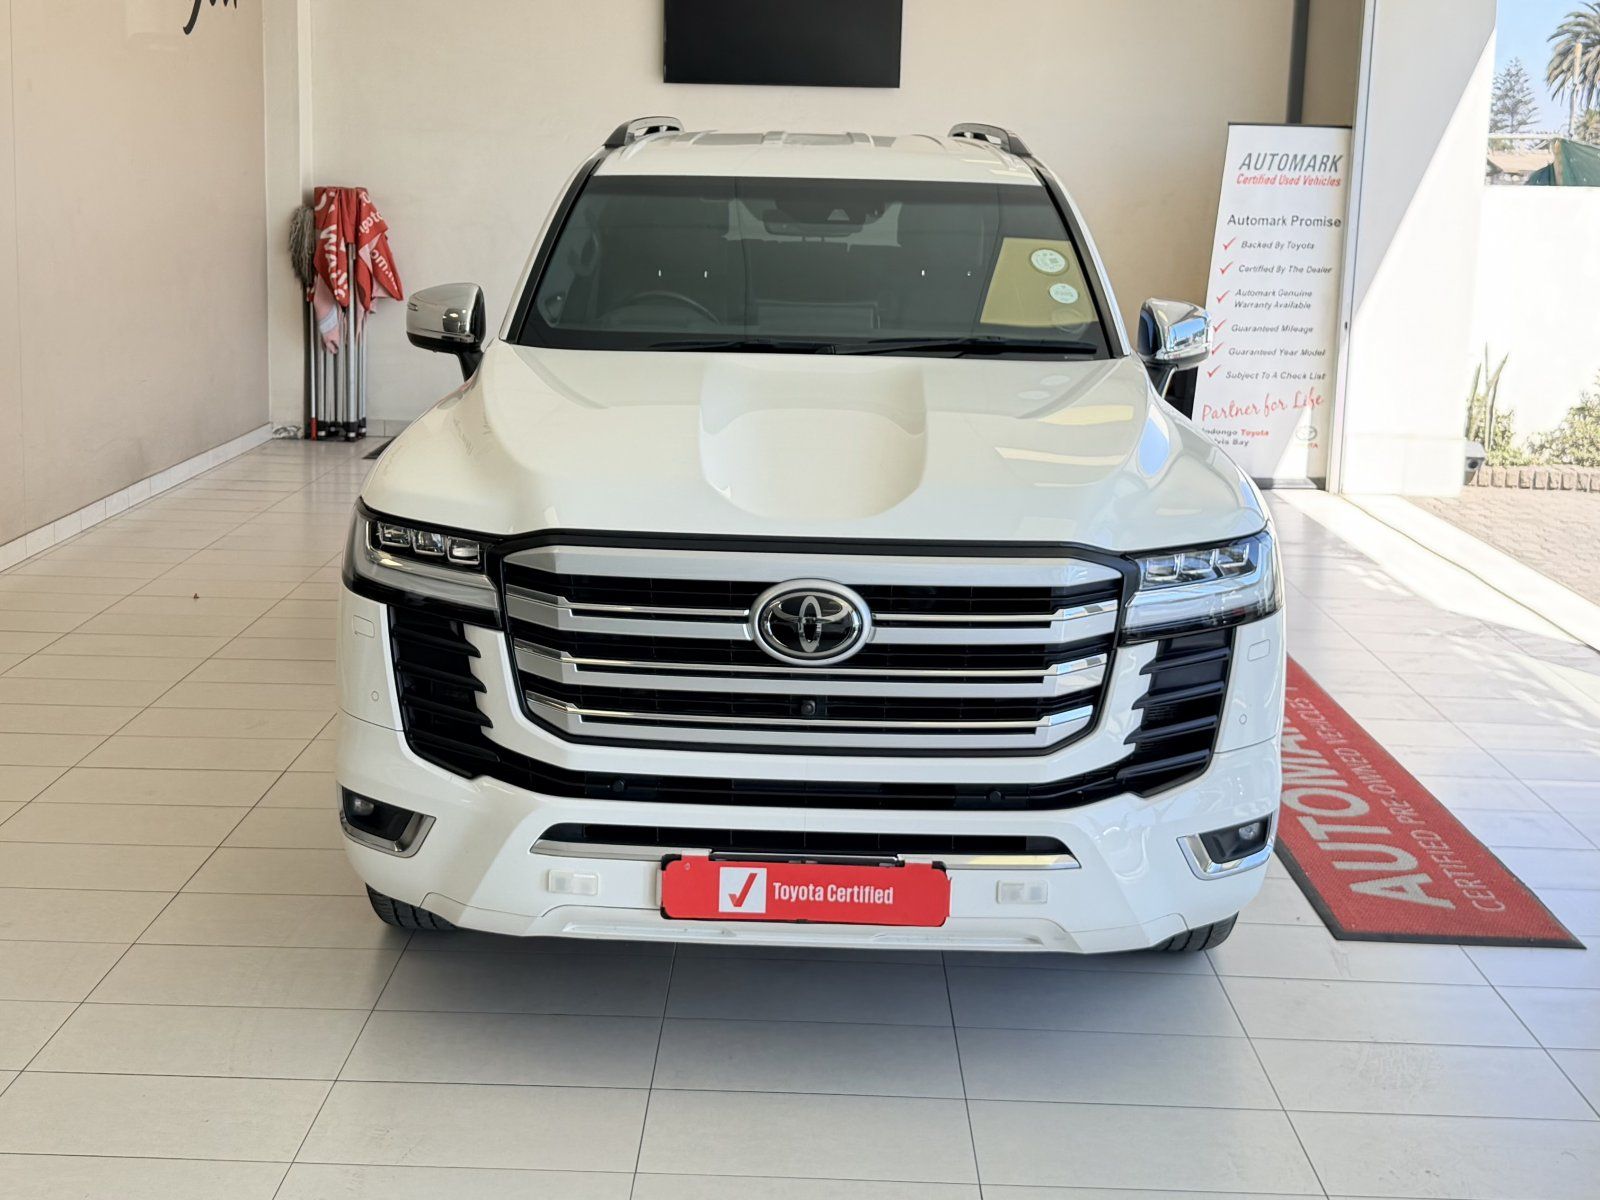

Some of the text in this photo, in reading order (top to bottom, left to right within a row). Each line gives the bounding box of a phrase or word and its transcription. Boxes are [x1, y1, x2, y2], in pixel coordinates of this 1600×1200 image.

[1238, 153, 1343, 173] AUTOMARK
[1236, 173, 1341, 187] Certified Used Vehicles
[1227, 214, 1342, 228] Automark Promise
[1241, 241, 1315, 251] Backed By Toyota
[1238, 264, 1274, 273] Certified
[1288, 265, 1304, 274] The
[1306, 265, 1332, 274] Dealer
[1235, 288, 1313, 298] Automark Genuine
[1234, 300, 1311, 310] Warranty Available
[1231, 324, 1314, 335] Guaranteed Mileage
[1228, 347, 1326, 357] Guaranteed Year Model
[1225, 371, 1259, 381] Subject
[1261, 372, 1271, 380] To
[1280, 371, 1307, 380] Check
[1202, 386, 1324, 421] Partner for Life
[1240, 428, 1270, 437] Toyota
[1410, 829, 1506, 912] CERTIFIED
[773, 882, 894, 905] Toyota Certified
